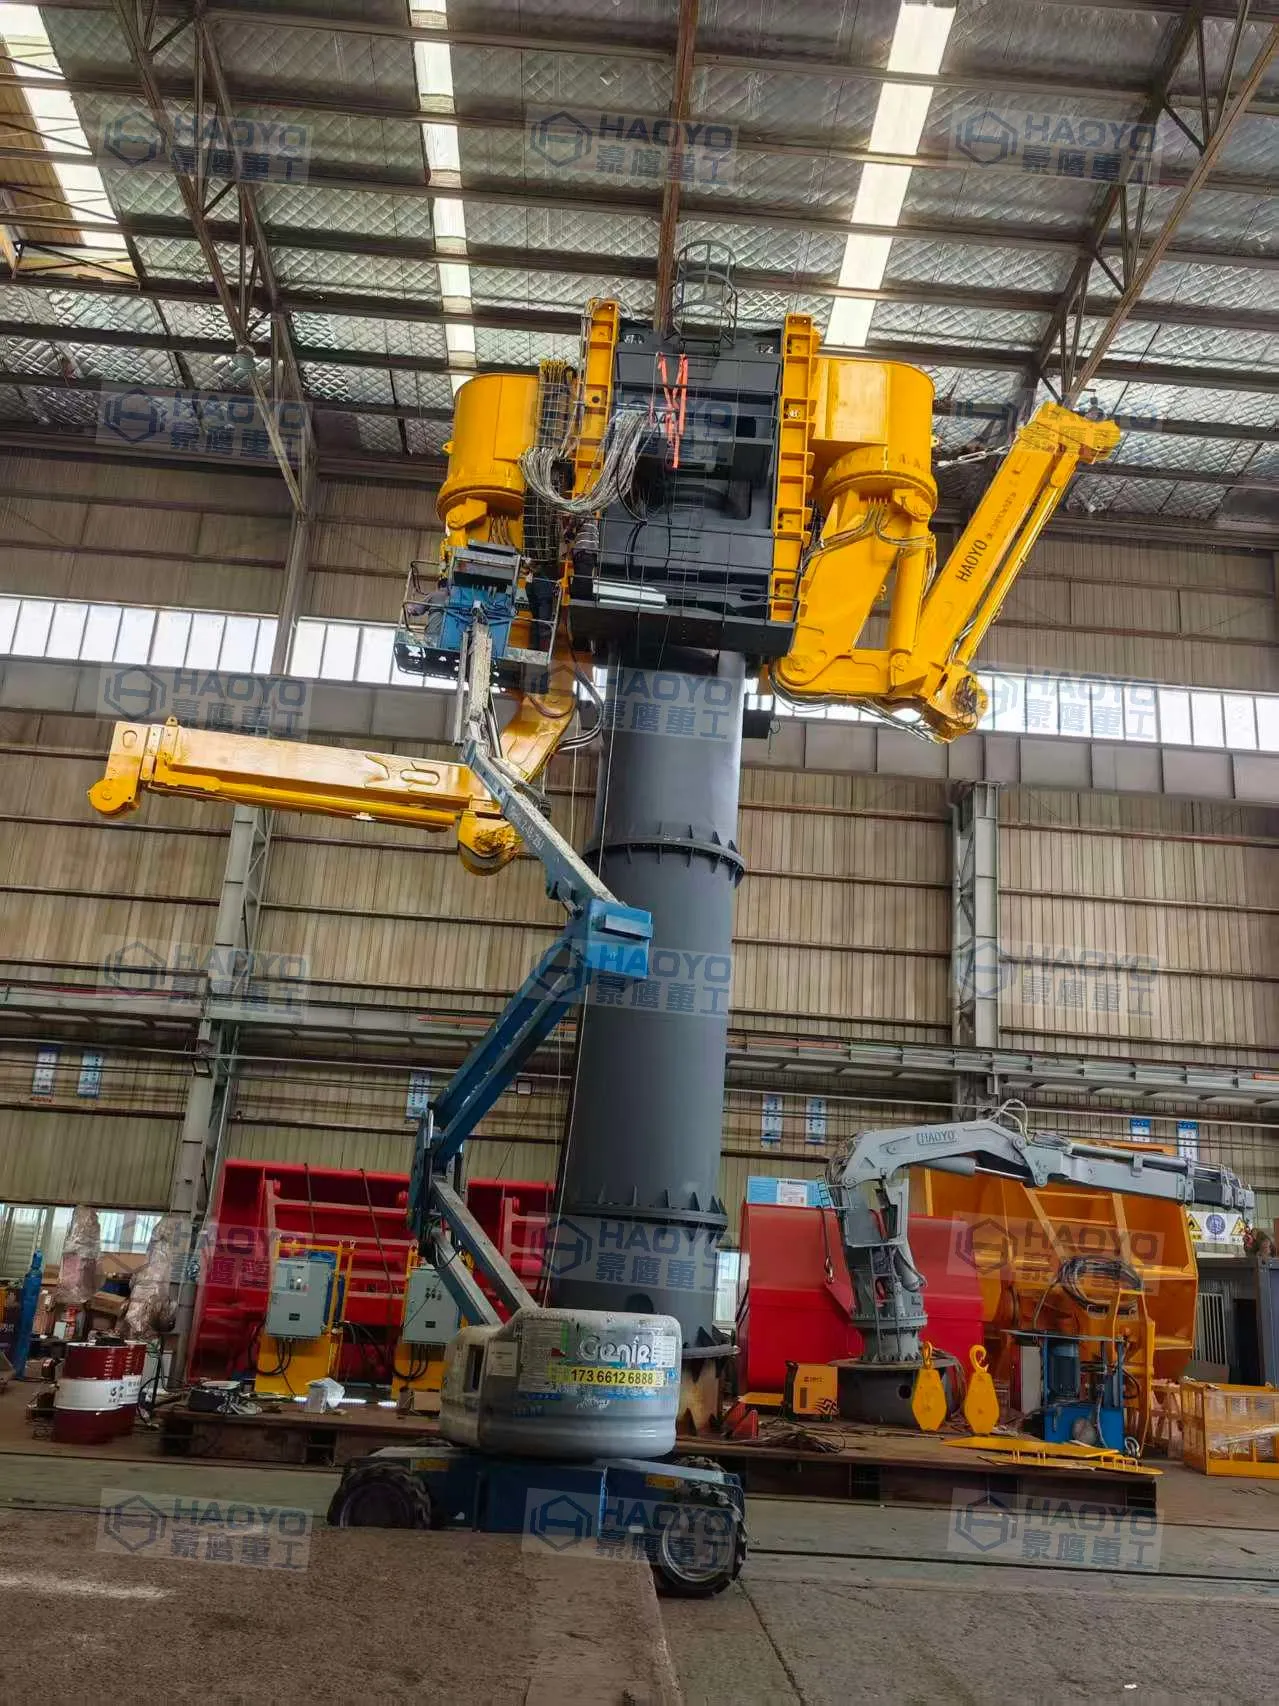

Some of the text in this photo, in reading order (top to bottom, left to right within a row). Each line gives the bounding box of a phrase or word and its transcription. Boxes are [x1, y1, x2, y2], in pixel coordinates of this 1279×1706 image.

[957, 539, 987, 582] HAOYO
[579, 1335, 652, 1369] Genie
[571, 1369, 654, 1386] 173 6612 6888
